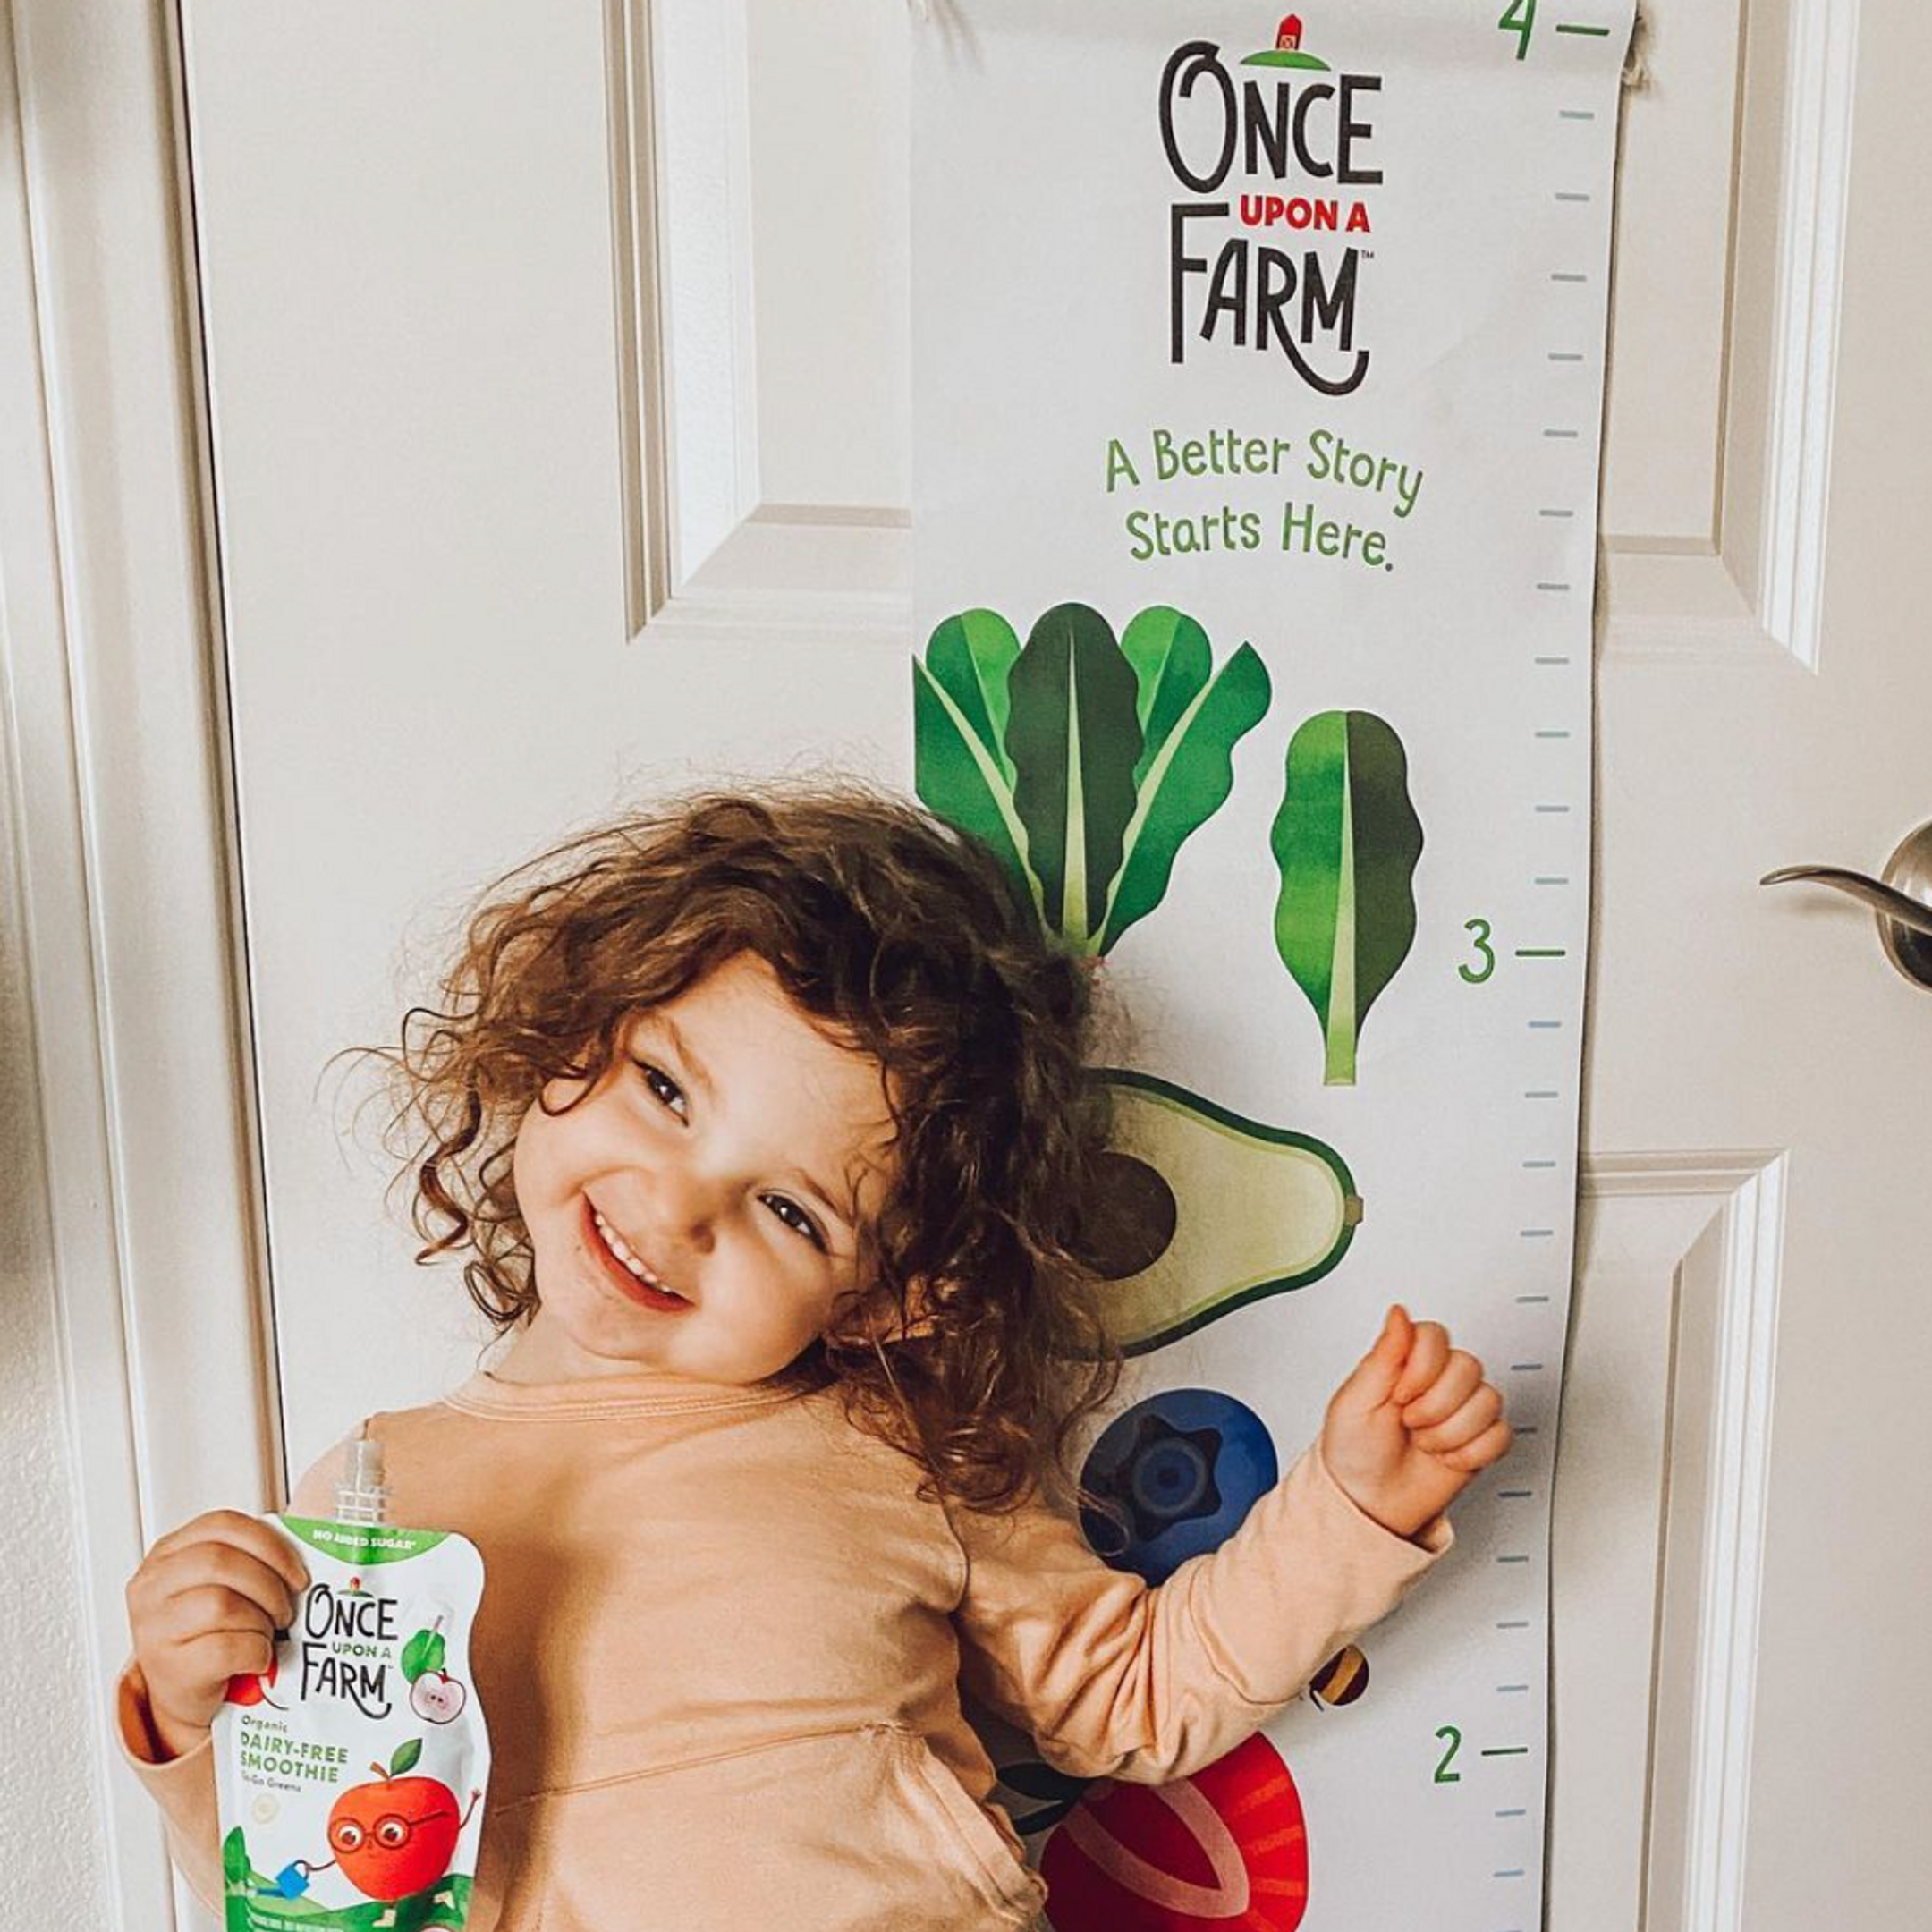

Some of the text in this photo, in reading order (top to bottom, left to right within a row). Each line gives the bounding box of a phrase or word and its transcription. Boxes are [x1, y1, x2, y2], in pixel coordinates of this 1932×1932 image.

[1498, 0, 1537, 61] 4
[1159, 41, 1384, 194] ONCE
[1240, 194, 1371, 233] UPON A
[1170, 202, 1370, 397] FARM
[1106, 429, 1424, 519] A Better Story
[1126, 503, 1394, 572] Starts Here.
[1458, 919, 1496, 984] 3
[313, 1528, 333, 1541] NO
[305, 1582, 398, 1640] ONCE
[300, 1640, 393, 1720] FARM
[332, 1642, 392, 1659] UPON A
[241, 1714, 288, 1733] Organic
[241, 1731, 349, 1765] DAIRY-FREE
[241, 1750, 339, 1784] SMOOTHIE
[1434, 1725, 1462, 1784] 2
